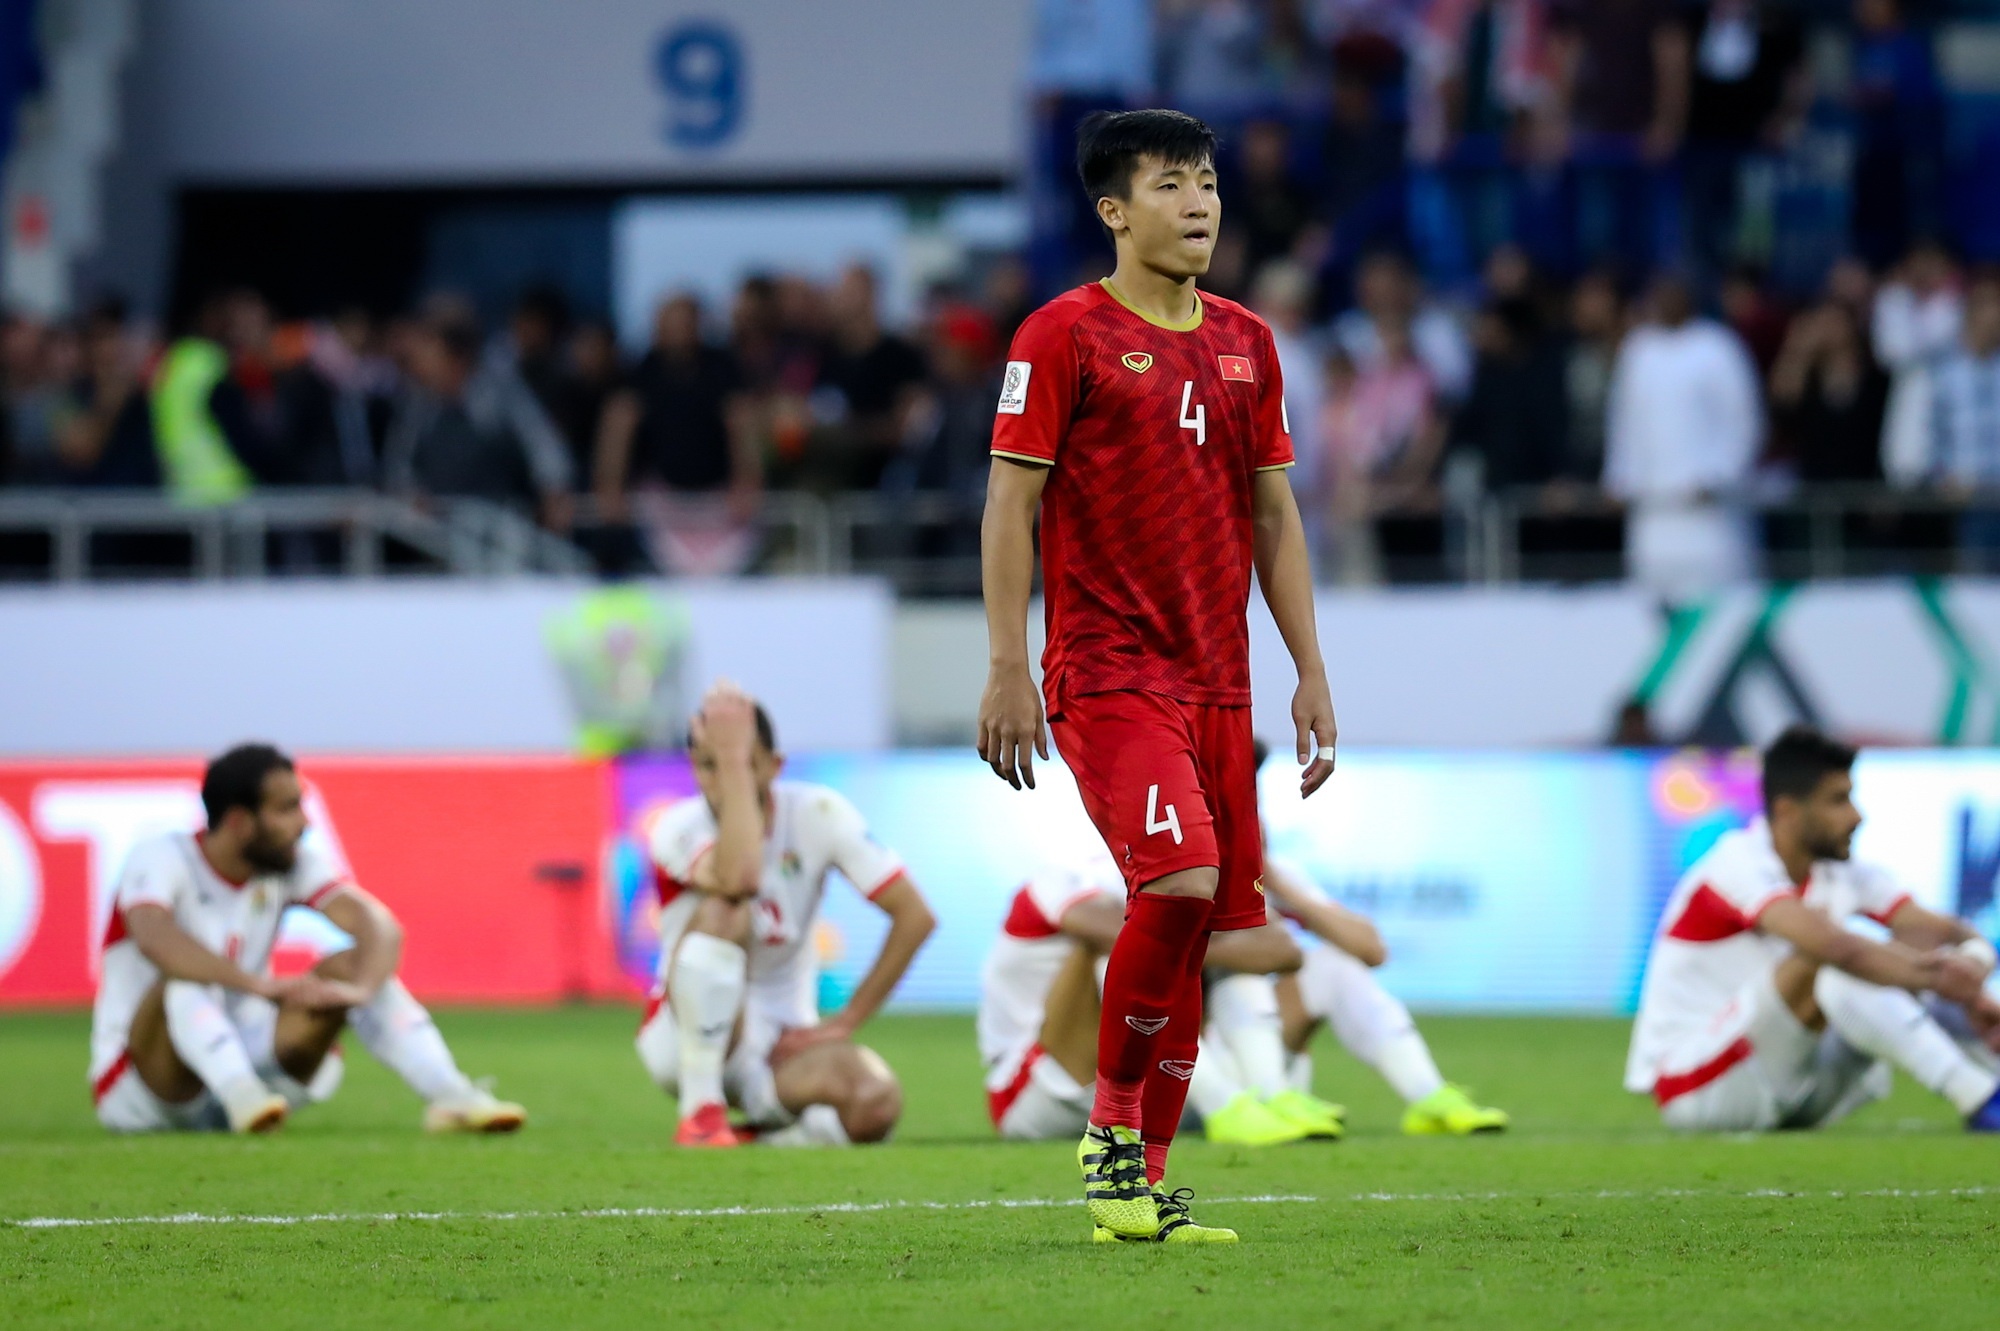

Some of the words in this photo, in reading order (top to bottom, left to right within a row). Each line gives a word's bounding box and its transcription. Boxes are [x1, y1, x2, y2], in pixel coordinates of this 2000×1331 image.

[652, 19, 746, 150] 9
[1179, 380, 1206, 445] 4
[1145, 784, 1183, 845] 4
